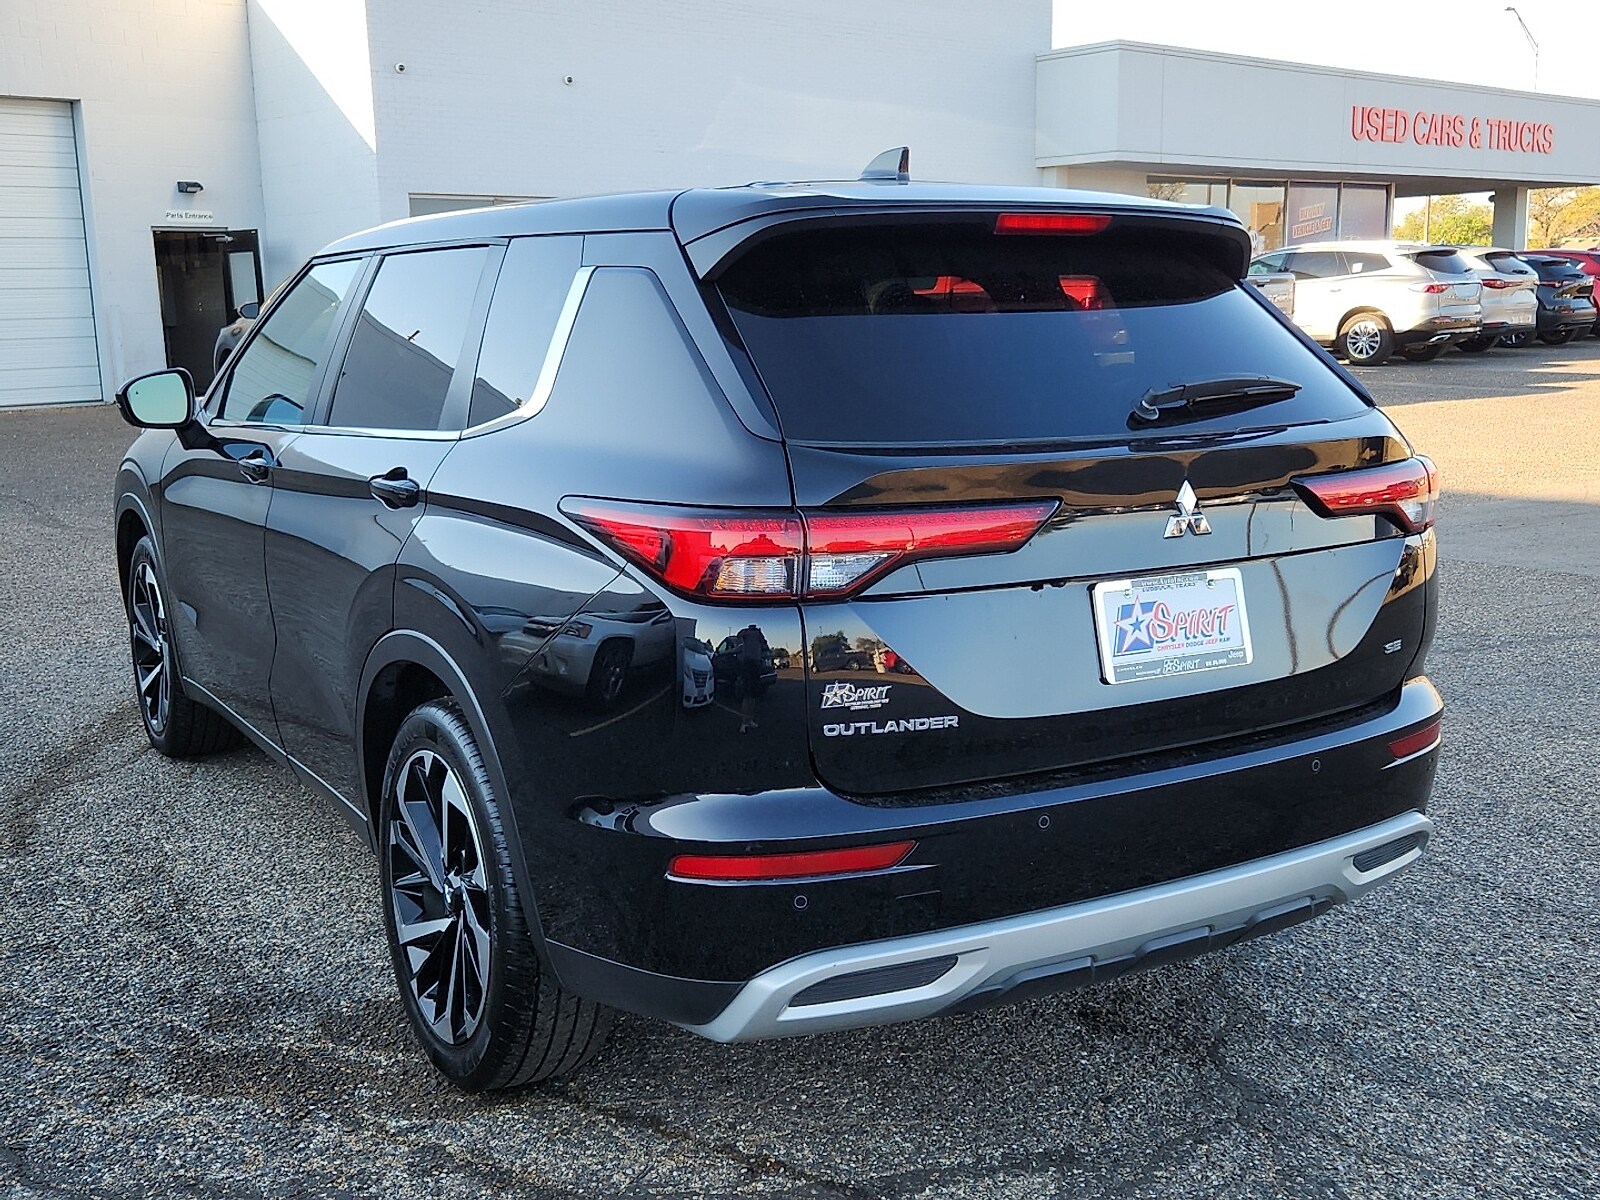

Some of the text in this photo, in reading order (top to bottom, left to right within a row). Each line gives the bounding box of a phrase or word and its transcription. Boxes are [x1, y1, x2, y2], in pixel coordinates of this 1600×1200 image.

[1352, 105, 1554, 154] USED CARS & TRUCKS
[1157, 643, 1184, 652] CHRYSLER
[1383, 639, 1402, 654] SE
[1228, 650, 1244, 659] Jeep
[823, 715, 959, 737] OUTLANDER
